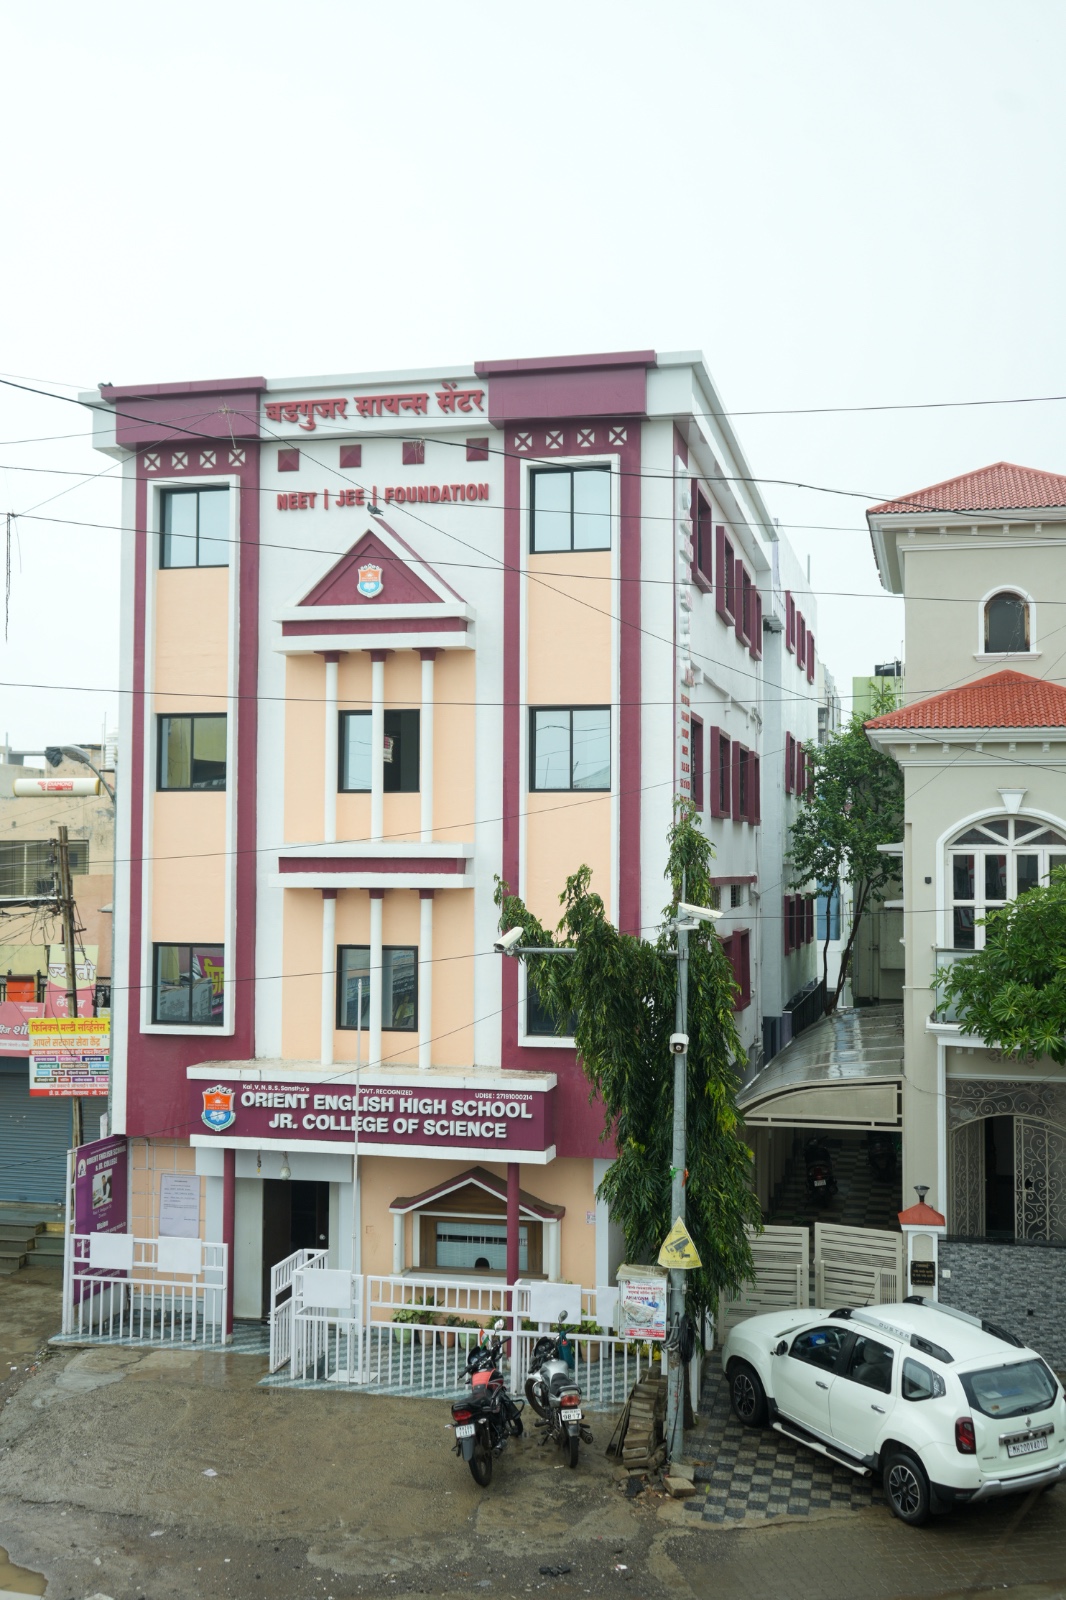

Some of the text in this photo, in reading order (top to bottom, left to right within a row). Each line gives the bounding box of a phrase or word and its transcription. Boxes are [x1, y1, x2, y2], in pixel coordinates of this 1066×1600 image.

[264, 382, 485, 431] बडगुजर सायन्स सेंटर
[277, 492, 318, 510] NEET
[336, 489, 365, 507] JEE
[385, 483, 489, 504] FOUNDATION
[240, 1091, 533, 1120] ORIENT ENGLISH HIGH SCHOOL
[268, 1113, 508, 1139] JR. COLLEGE OF SCIENCE
[878, 1322, 910, 1339] DUSTER
